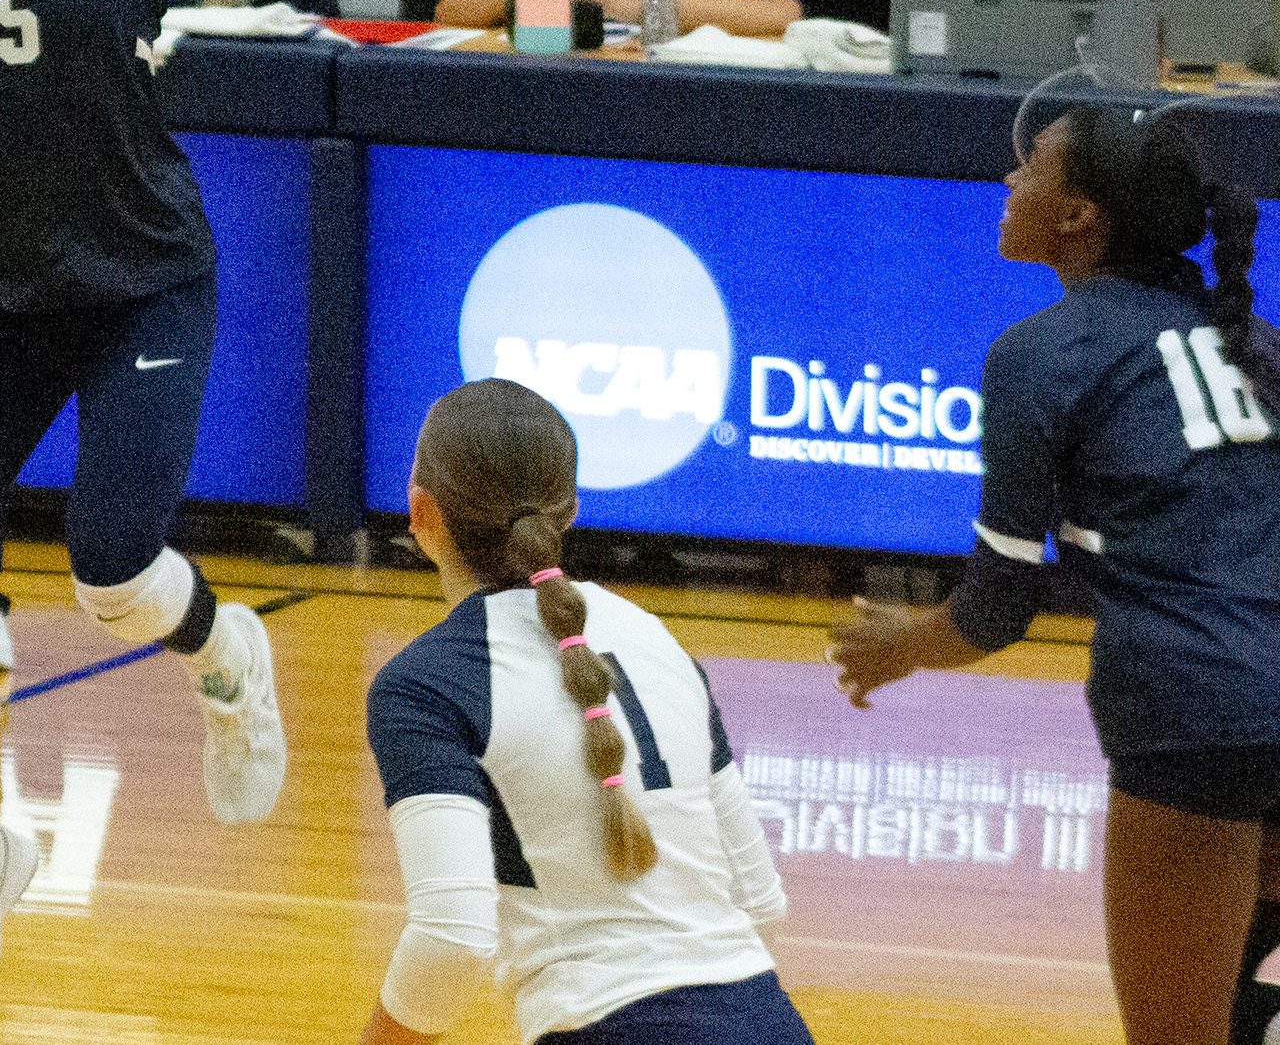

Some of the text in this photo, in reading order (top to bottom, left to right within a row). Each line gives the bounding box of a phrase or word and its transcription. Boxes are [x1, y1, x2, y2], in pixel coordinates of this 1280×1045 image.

[493, 336, 723, 425] NCAA
[1156, 326, 1272, 449] 16
[749, 435, 882, 468] DISCOVER
